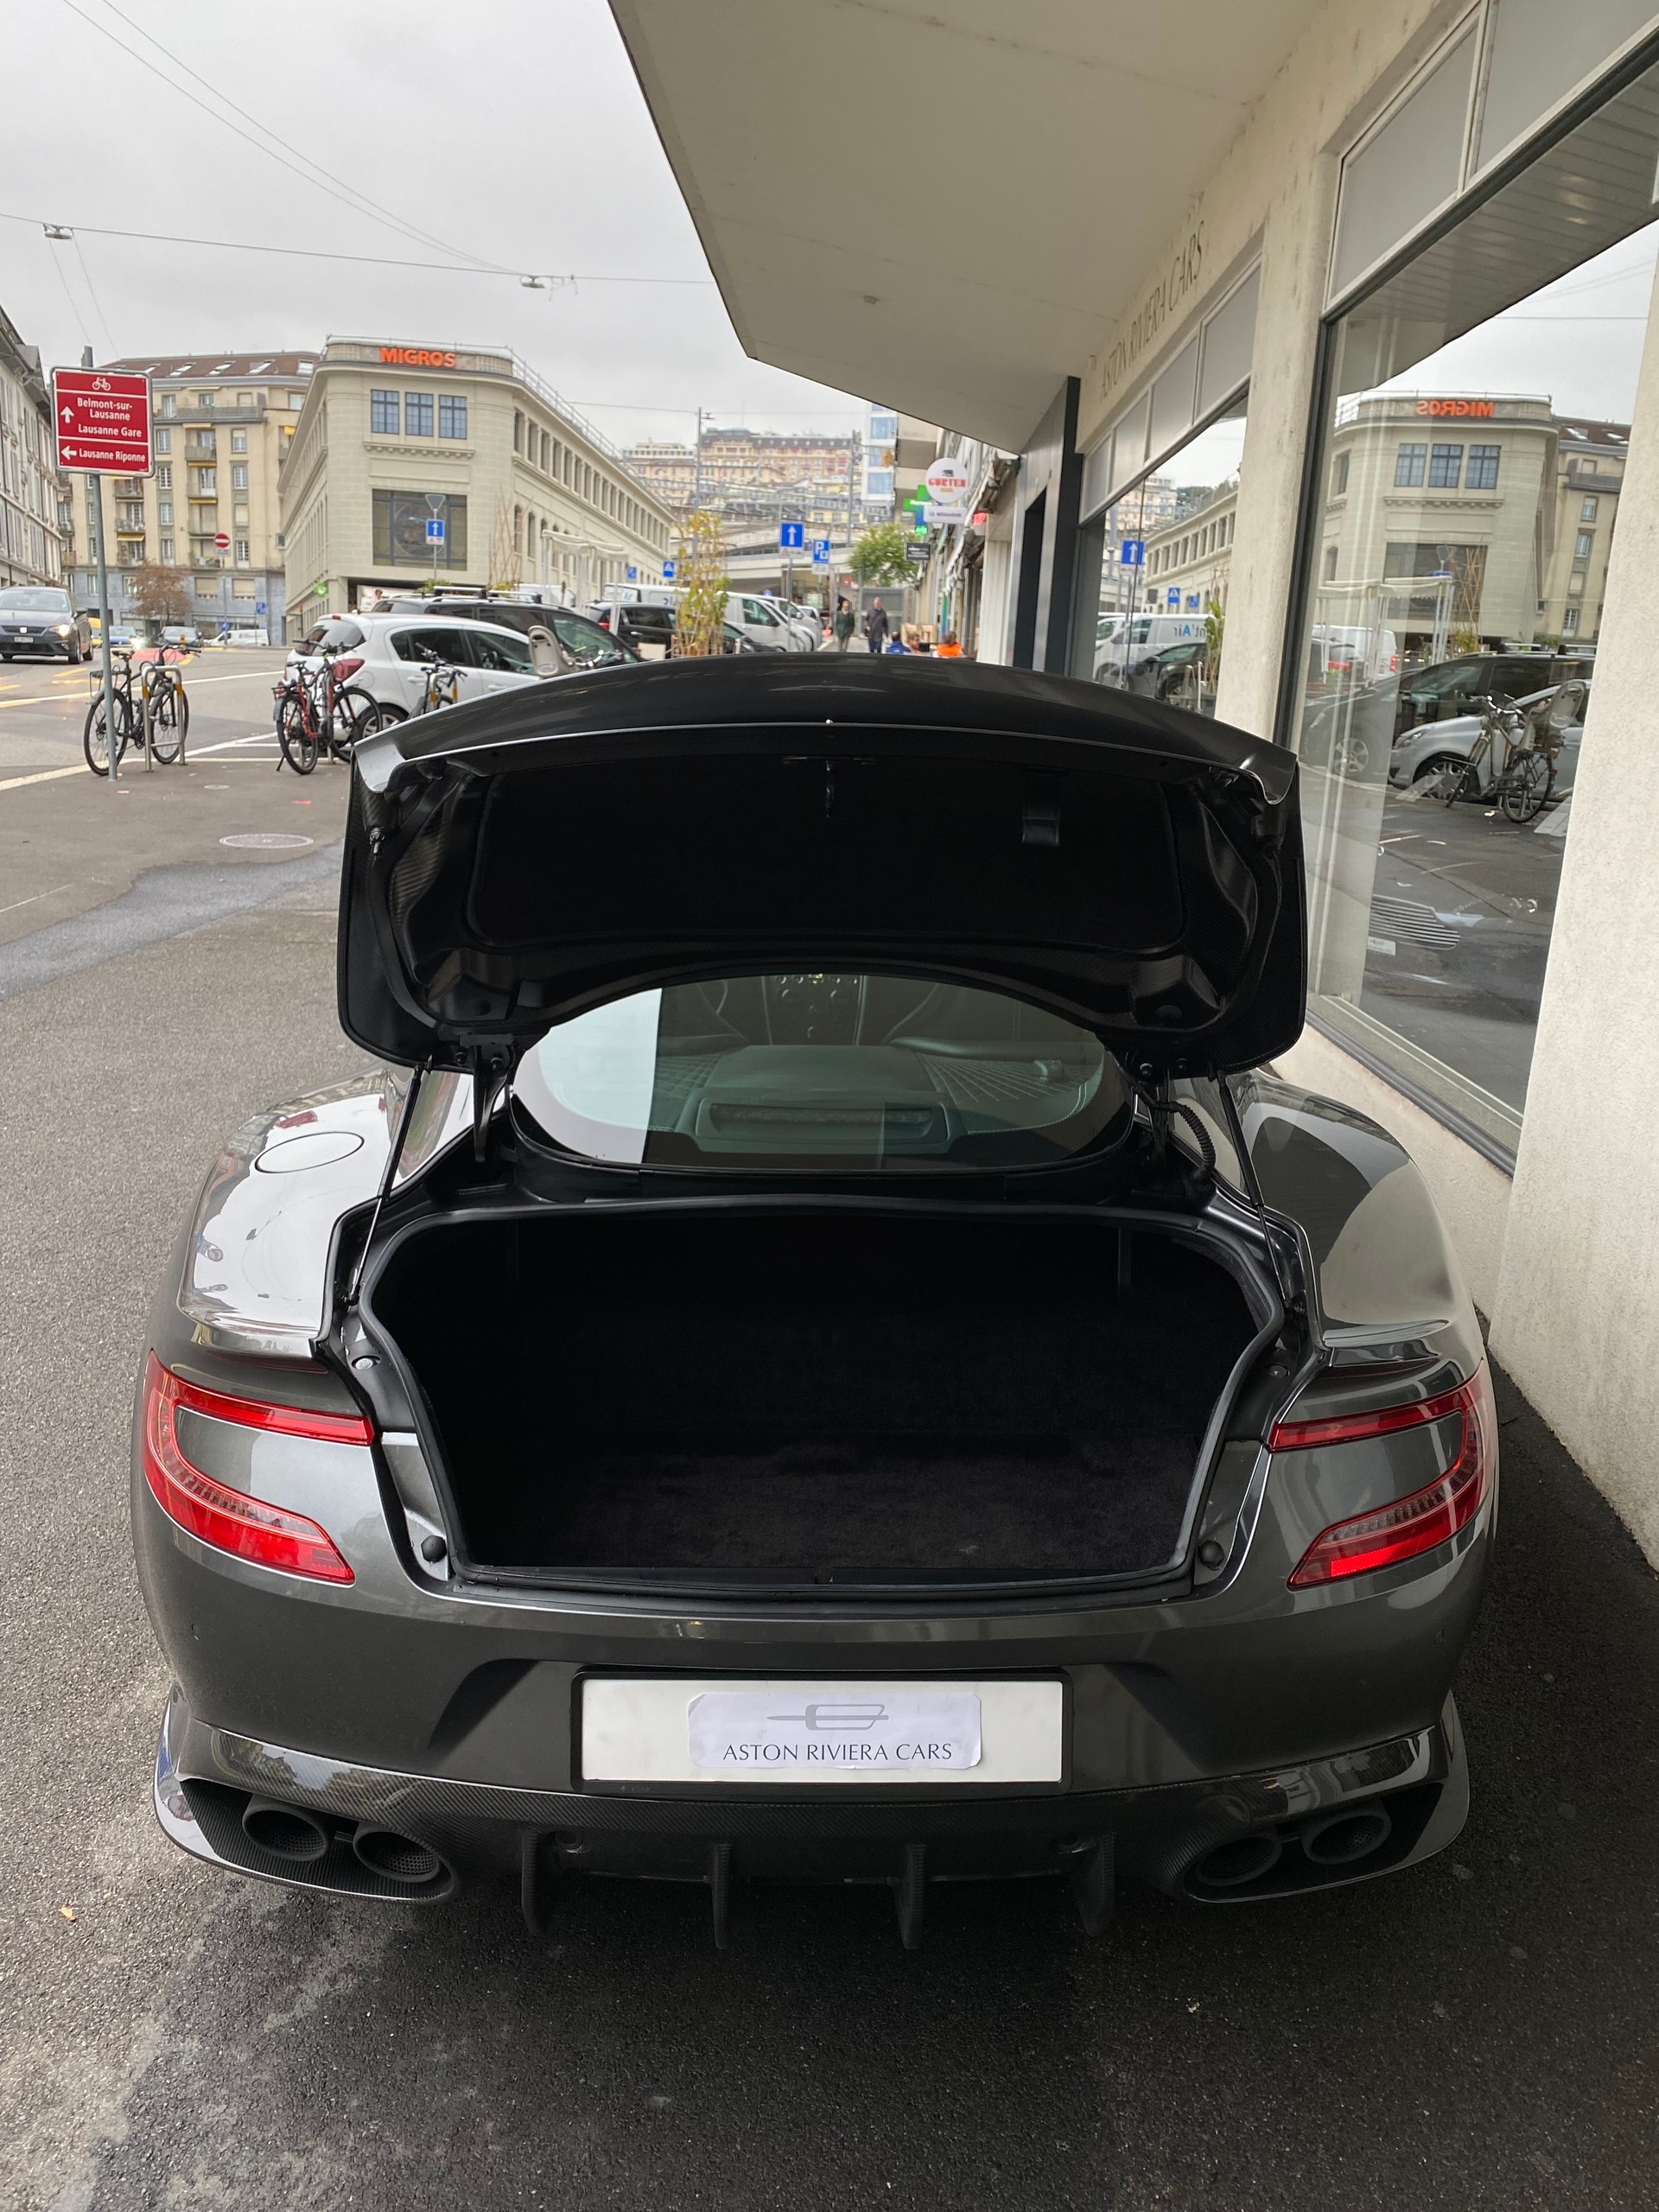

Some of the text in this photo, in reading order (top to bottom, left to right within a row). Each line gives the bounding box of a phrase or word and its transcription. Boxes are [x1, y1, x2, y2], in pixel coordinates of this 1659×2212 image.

[1099, 219, 1204, 404] ASTON RIVIERA CARS
[380, 346, 457, 368] MIGROS
[77, 397, 133, 410] Belmont-sur-
[90, 409, 130, 421] Lausanne
[78, 423, 143, 437] Lausanne Gare
[79, 448, 146, 463] Lausanne Riponne
[722, 1743, 952, 1761] ASTON RIVIERA CARS
